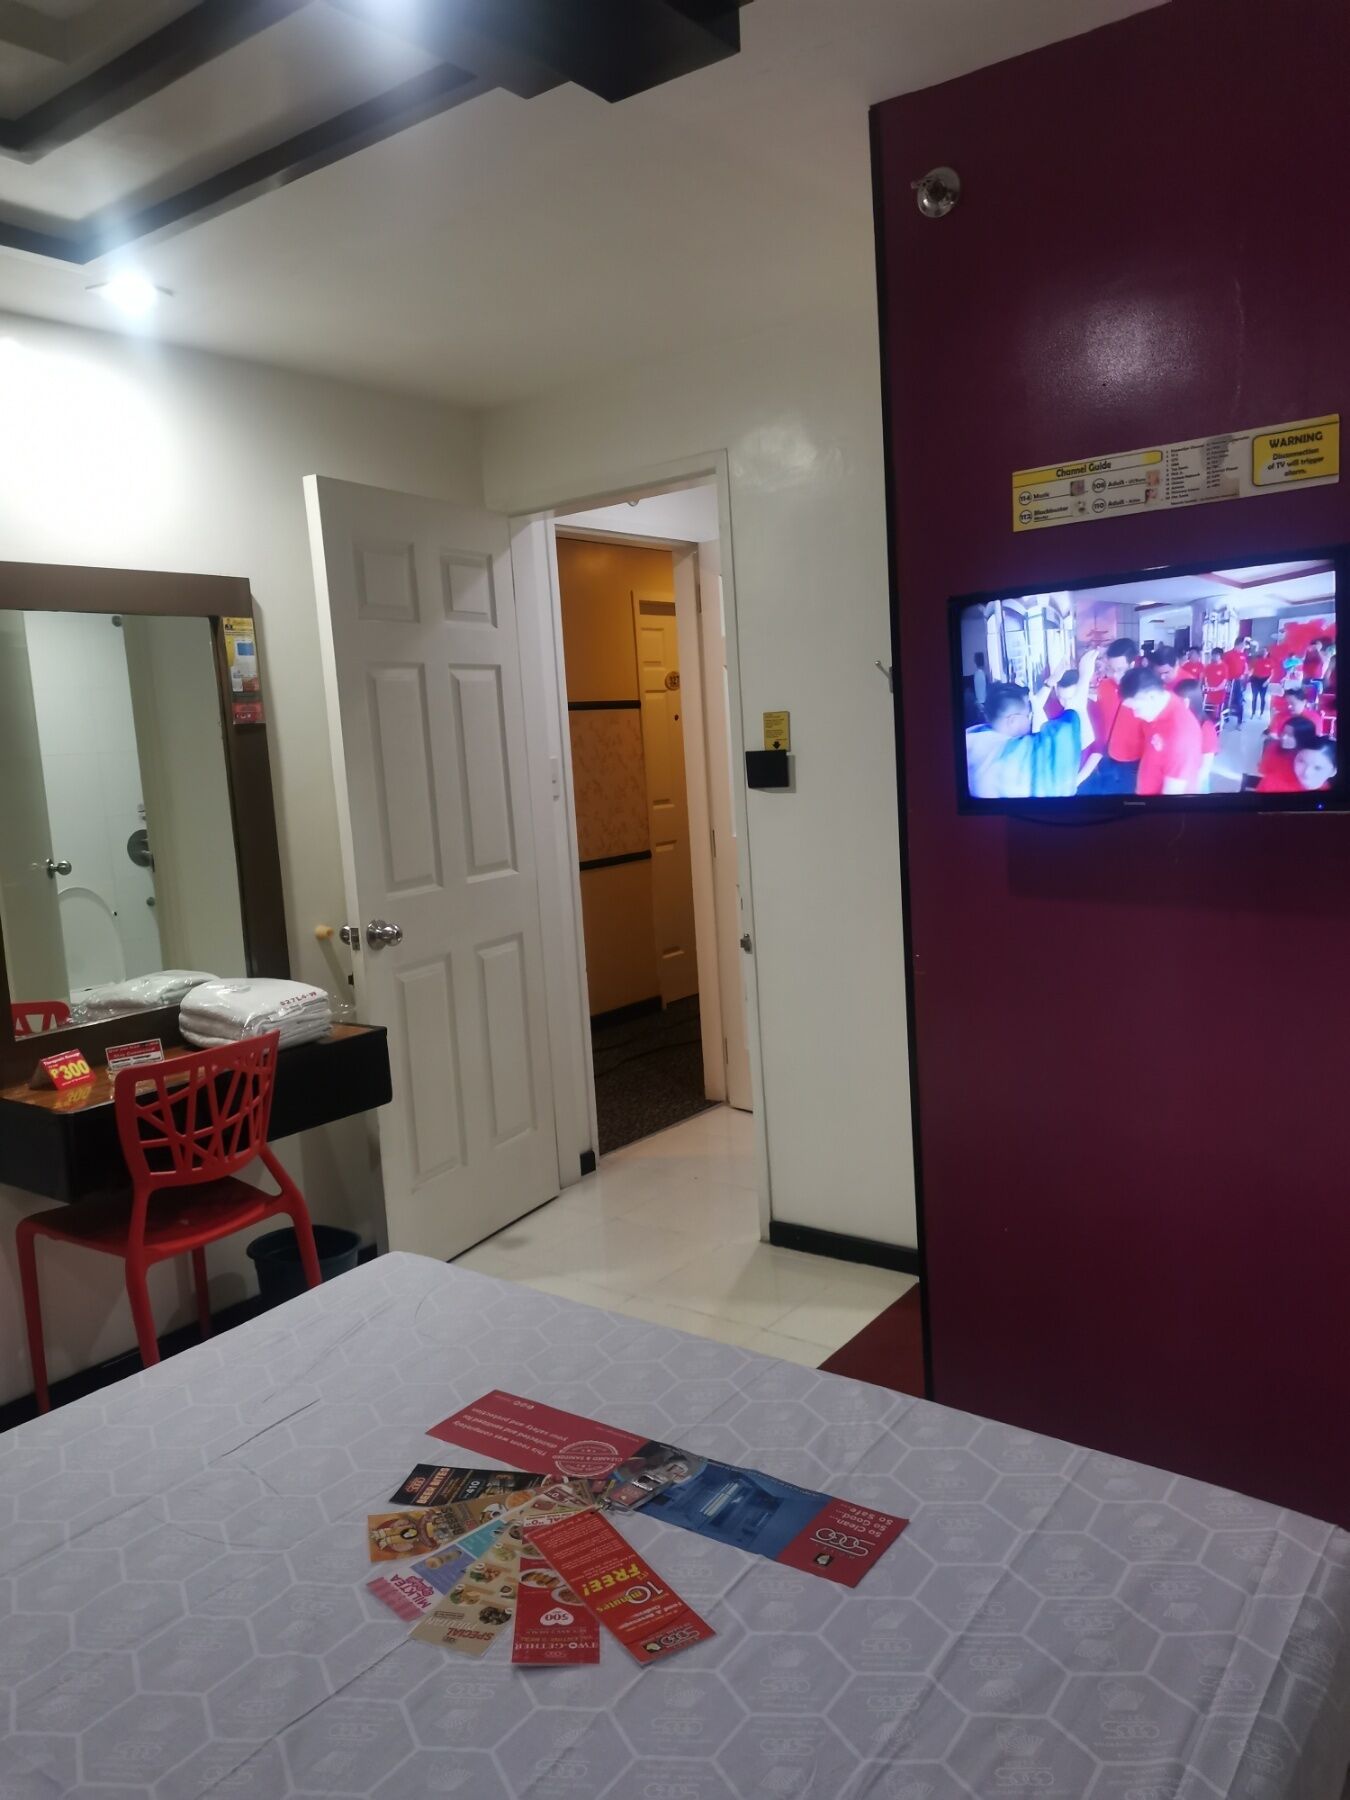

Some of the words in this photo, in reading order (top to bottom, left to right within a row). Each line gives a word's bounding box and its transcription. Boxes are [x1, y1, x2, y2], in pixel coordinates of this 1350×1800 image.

[1269, 431, 1323, 449] WARNING
[1056, 463, 1087, 478] Channel
[1088, 460, 1112, 473] Guide
[1276, 461, 1286, 469] TV
[508, 1439, 530, 1450] room
[873, 1522, 887, 1532] So
[879, 1516, 894, 1526] So
[868, 1529, 882, 1538] So
[581, 1562, 641, 1597] FREE!
[390, 1574, 432, 1609] MILKTEA
[626, 1581, 664, 1604] 10
[596, 1590, 643, 1613] minutes
[544, 1613, 569, 1622] 500
[446, 1627, 495, 1641] SPECIAL
